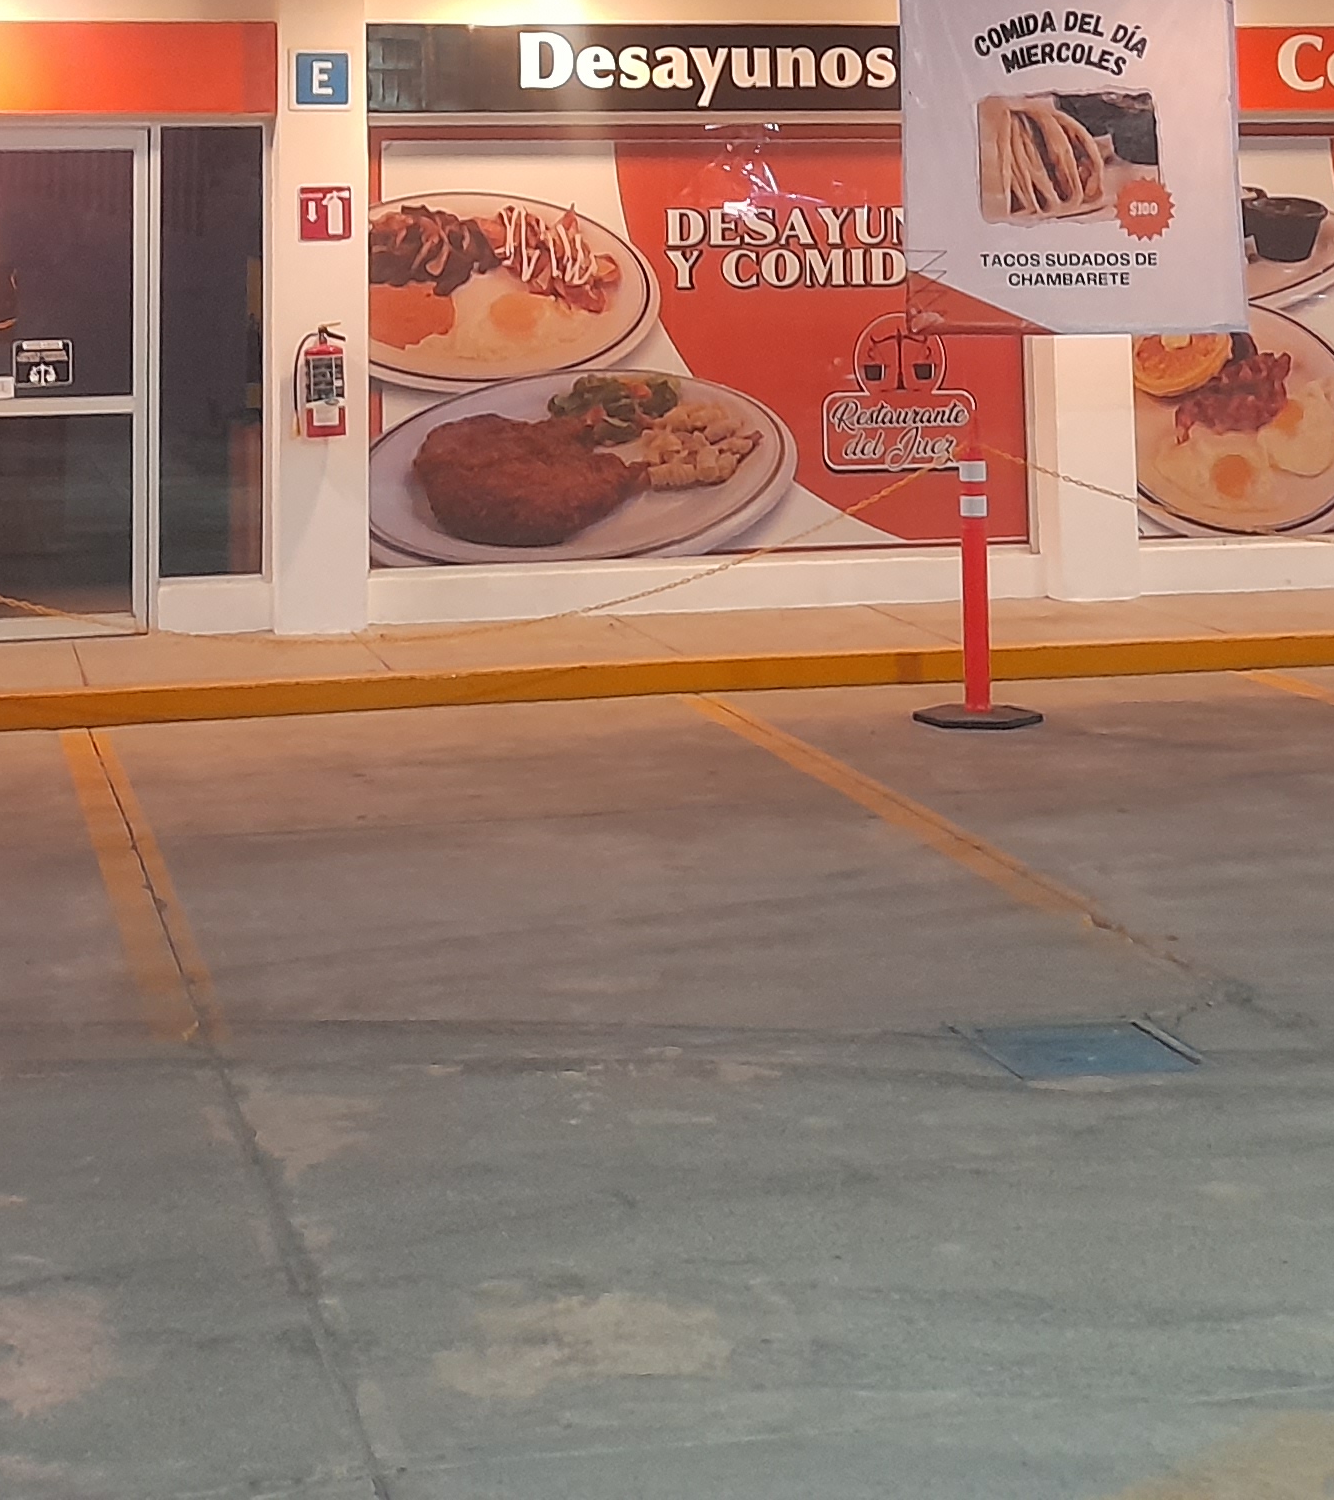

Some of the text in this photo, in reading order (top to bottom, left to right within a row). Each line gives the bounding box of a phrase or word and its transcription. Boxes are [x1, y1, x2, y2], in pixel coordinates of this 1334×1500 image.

[974, 11, 1148, 58] COMIDA DEL DÍA
[519, 31, 897, 108] Desayunos
[1001, 42, 1126, 76] MIERCOLES
[312, 60, 333, 96] E
[1129, 201, 1158, 216] $100
[667, 249, 700, 289] Y
[980, 252, 1158, 268] TACOS SUDADOS DE
[1008, 272, 1130, 286] CHAMBARETE
[830, 398, 969, 434] Restaurante
[843, 426, 956, 471] del Juez
